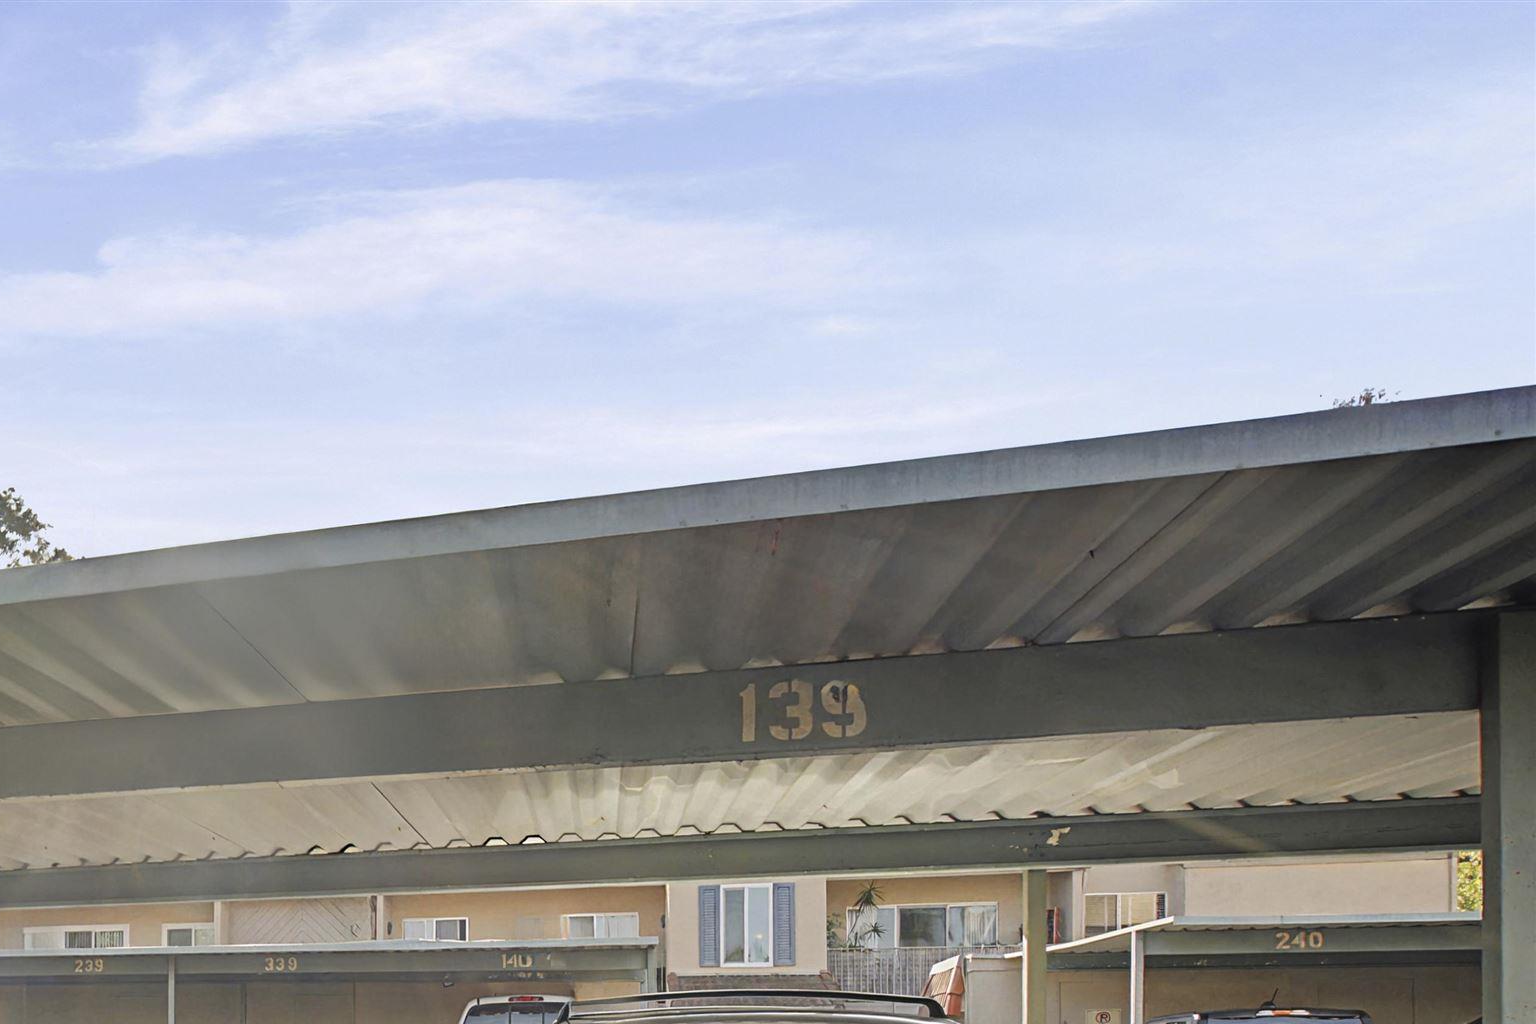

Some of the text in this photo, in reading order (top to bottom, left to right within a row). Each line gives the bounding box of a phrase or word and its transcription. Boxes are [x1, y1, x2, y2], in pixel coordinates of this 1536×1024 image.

[739, 679, 867, 743] 139
[1275, 931, 1324, 950] 240
[74, 958, 104, 973] 239
[264, 957, 298, 972] 339
